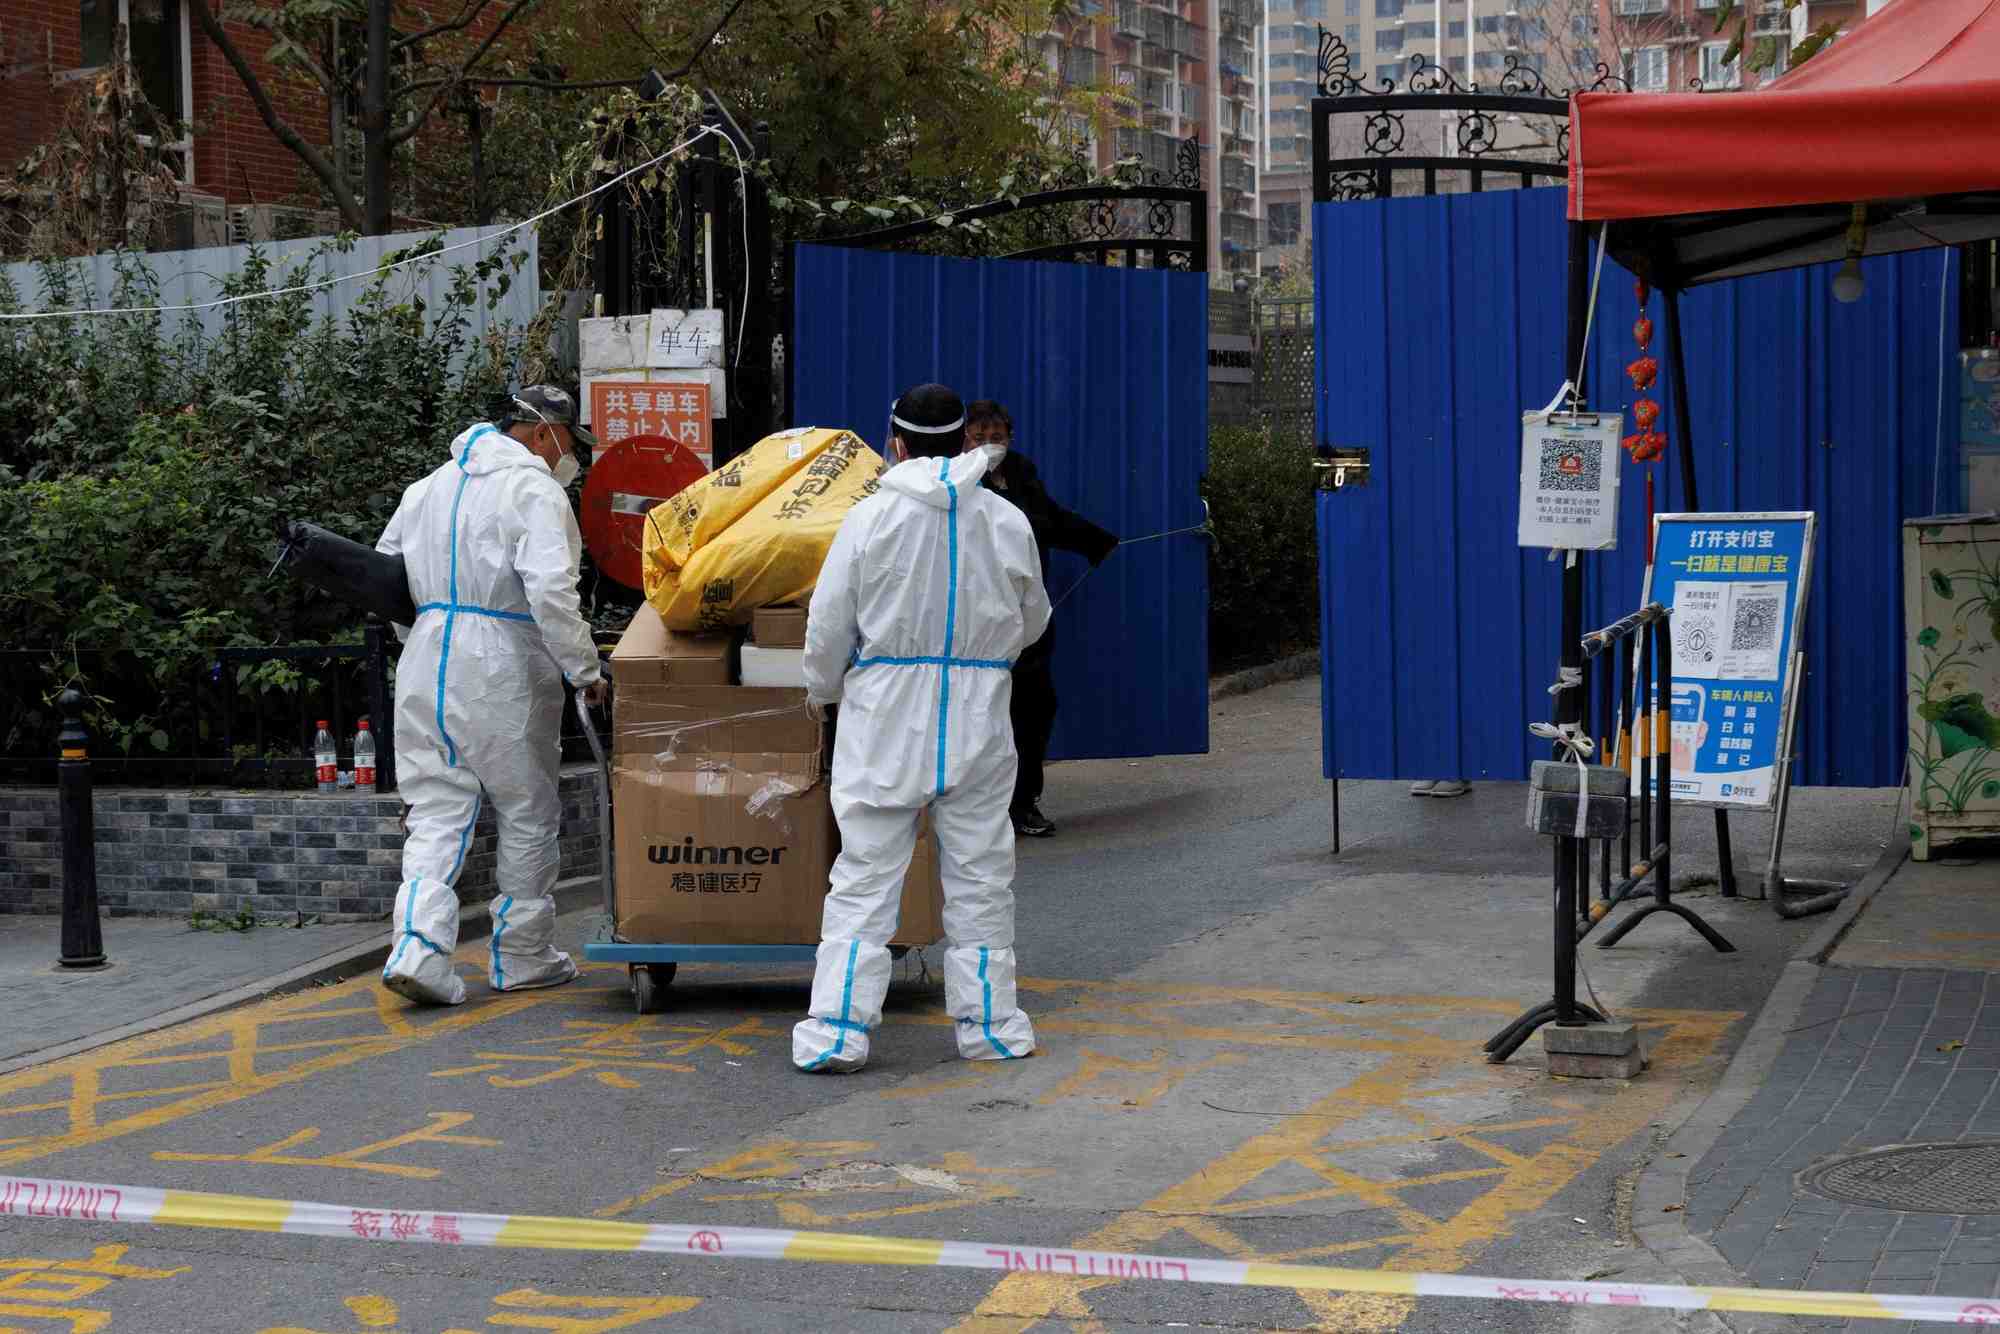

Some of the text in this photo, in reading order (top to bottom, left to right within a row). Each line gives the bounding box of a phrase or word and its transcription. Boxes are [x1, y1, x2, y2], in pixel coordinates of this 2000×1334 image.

[656, 325, 710, 355] 单车
[606, 391, 700, 416] 共享单车
[606, 418, 701, 443] 禁止入内
[1689, 530, 1775, 548] 打开支付宝
[1670, 555, 1788, 573] 一扫就是健康宝
[648, 836, 788, 865] winner
[671, 872, 762, 893] 稳健医疗
[351, 1209, 464, 1243] 警戒线
